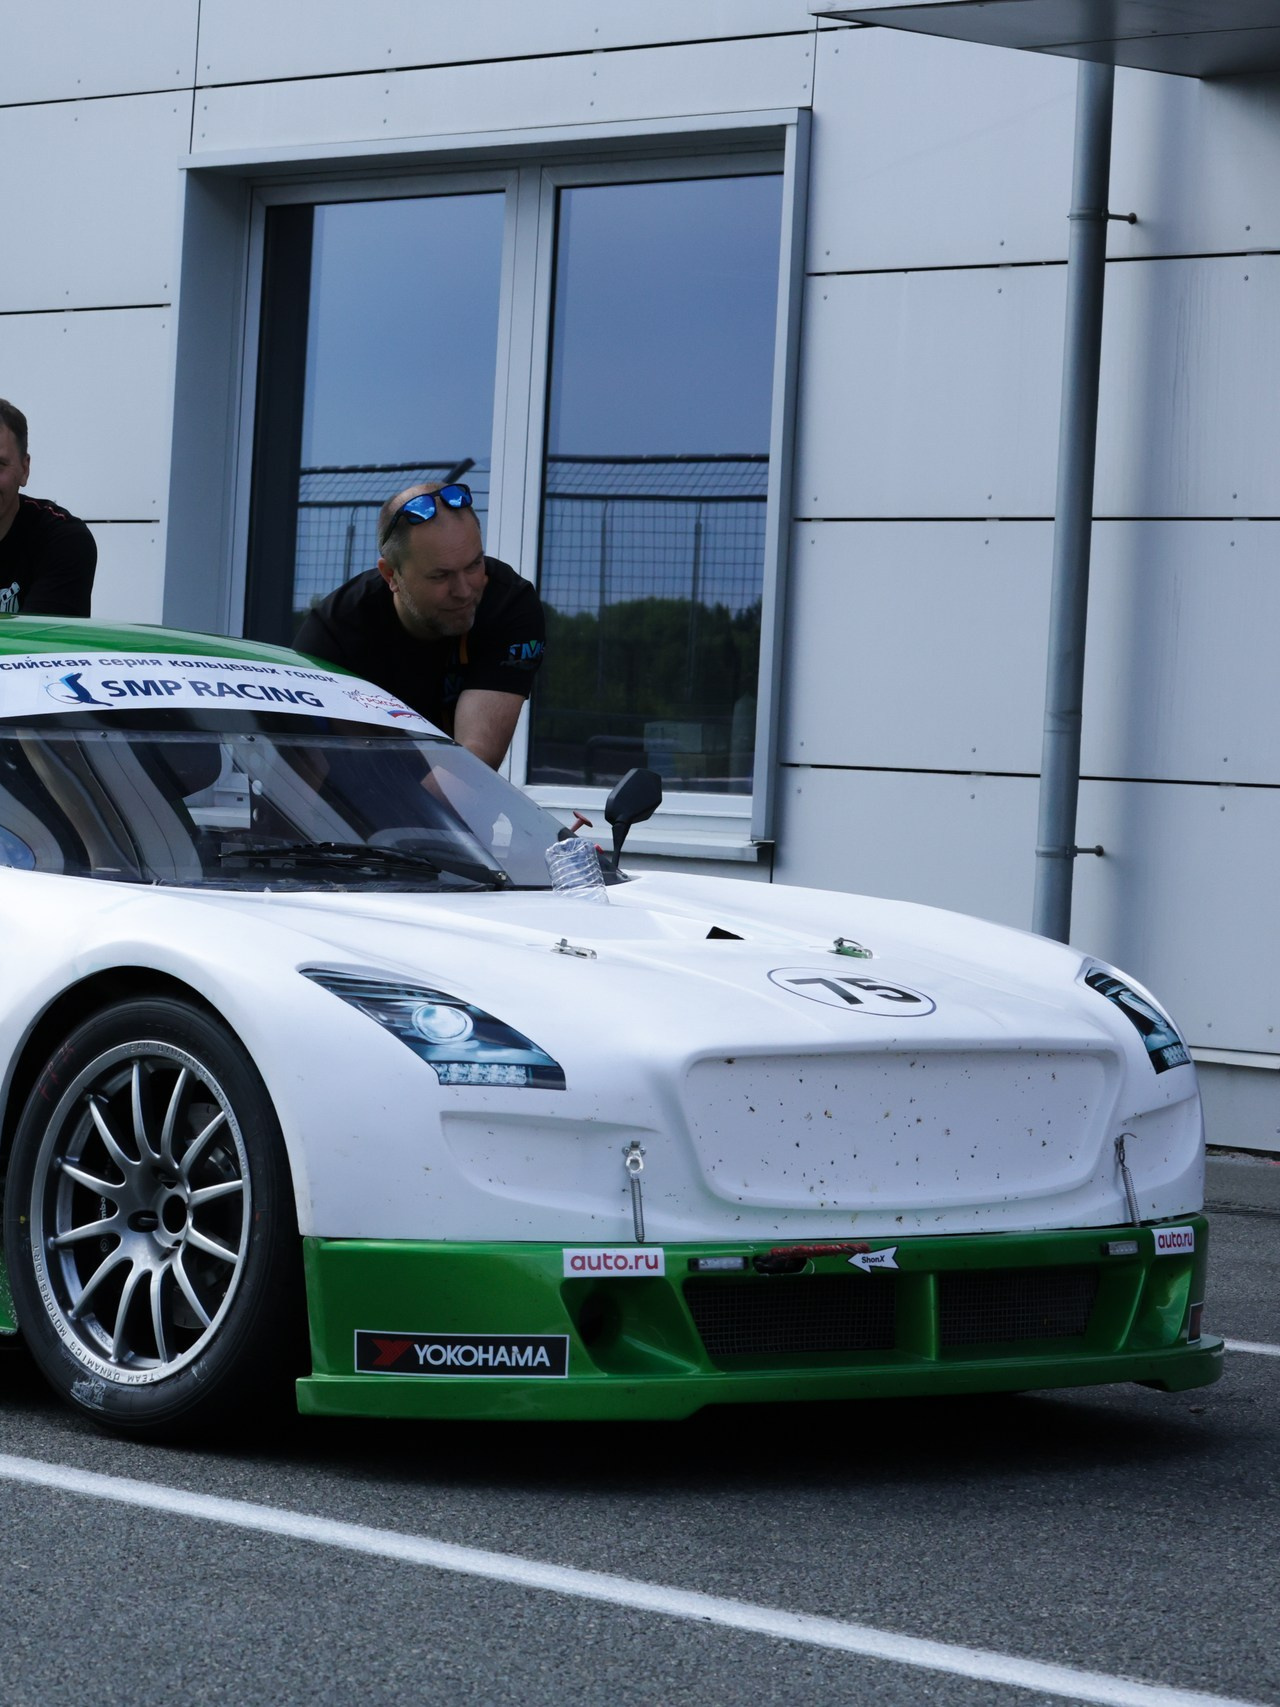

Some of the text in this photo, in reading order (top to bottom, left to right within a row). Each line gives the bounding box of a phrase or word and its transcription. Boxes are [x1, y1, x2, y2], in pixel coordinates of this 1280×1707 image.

[99, 659, 163, 668] серия
[169, 660, 281, 675] кольцевых
[284, 669, 340, 684] гонок
[101, 679, 182, 697] SMP
[188, 680, 325, 708] RACING
[784, 977, 922, 1005] 75
[1158, 1232, 1193, 1249] auto.ru
[570, 1251, 659, 1272] auto.ru
[861, 1255, 886, 1264] ShonX
[32, 1242, 67, 1338] MOTORSPORT
[69, 1341, 121, 1381] DYNAMICS
[413, 1344, 551, 1368] YOKOHAMA
[126, 1373, 155, 1384] TEAM
